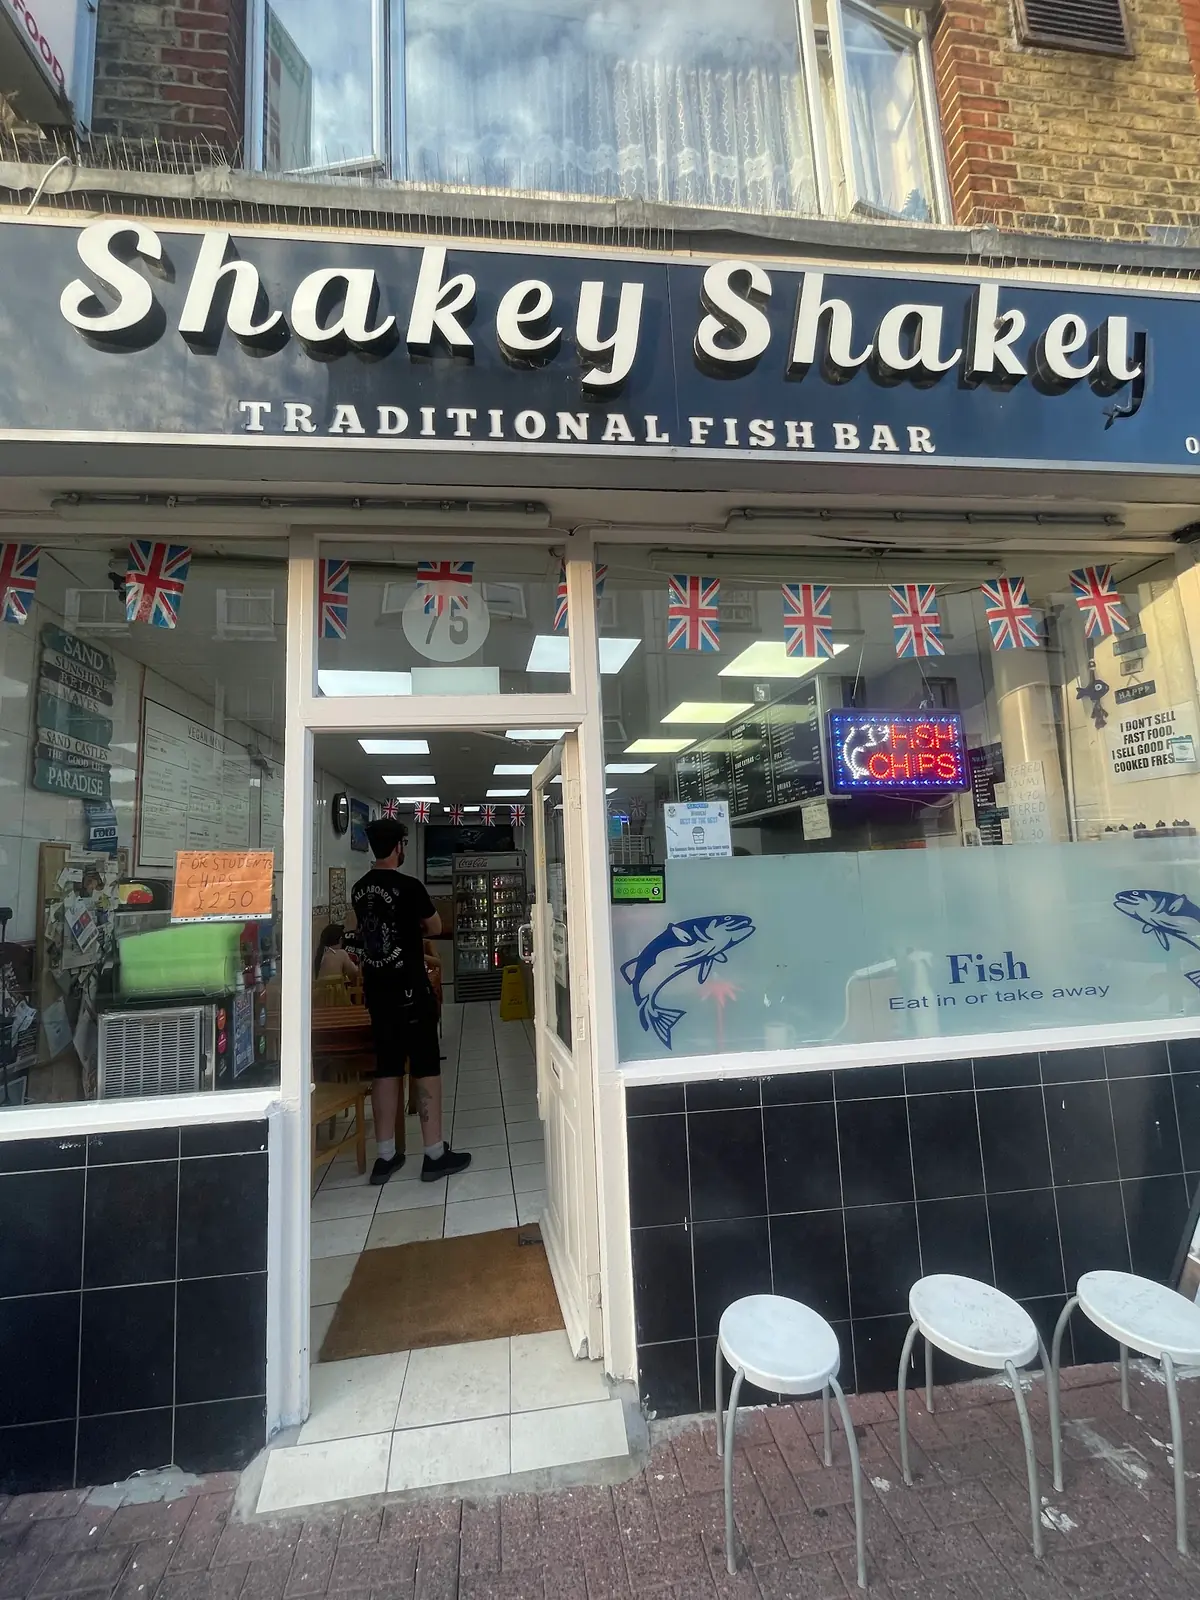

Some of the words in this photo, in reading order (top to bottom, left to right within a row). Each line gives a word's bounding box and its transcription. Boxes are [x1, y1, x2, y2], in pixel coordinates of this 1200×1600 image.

[59, 219, 645, 388] Shakey
[239, 400, 670, 445] TRADITIONAL
[688, 415, 816, 450] FISH
[832, 422, 937, 455] BAR
[424, 594, 469, 645] 75
[64, 635, 104, 671] SAND
[55, 655, 109, 692] SUNSHINE
[60, 671, 102, 699] RELAX
[63, 686, 100, 713] WAVES
[187, 724, 208, 743] VEGAN
[1120, 722, 1124, 733] I
[1125, 716, 1153, 732] DON'T
[1154, 710, 1176, 725] SELL
[46, 730, 70, 749] SAND
[75, 741, 108, 760] CASTLES
[1111, 750, 1115, 760] I
[1116, 746, 1136, 759] SELL
[1137, 740, 1164, 755] GOOD
[1123, 731, 1145, 745] FAST
[48, 747, 63, 760] THE
[68, 754, 89, 768] GOOD
[868, 752, 956, 778] CHIPS
[1114, 757, 1149, 773] COOKED
[1150, 752, 1176, 767] FRES
[47, 766, 104, 796] PARADISE
[179, 857, 208, 870] FOR
[186, 872, 235, 889] CHIPS
[354, 889, 366, 902] ALL
[366, 885, 393, 903] ABOARD
[946, 951, 1030, 985] Fish
[889, 996, 929, 1010] Eat
[937, 993, 956, 1007] in
[965, 994, 985, 1005] or
[996, 988, 1044, 1002] take
[1052, 984, 1110, 998] away
